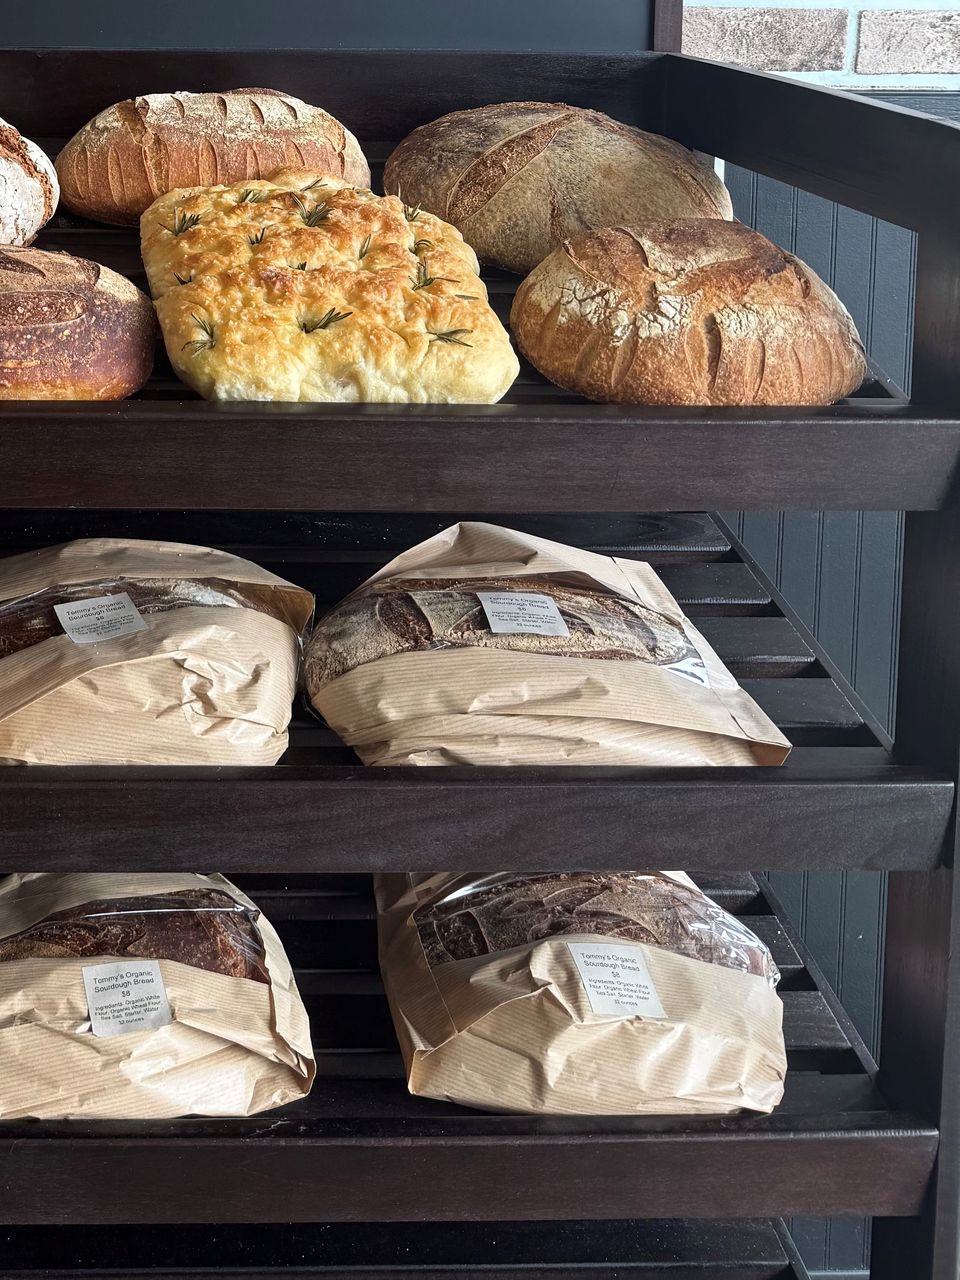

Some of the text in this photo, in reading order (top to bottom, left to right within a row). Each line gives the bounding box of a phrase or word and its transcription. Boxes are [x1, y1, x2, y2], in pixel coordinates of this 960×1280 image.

[580, 953, 637, 964] Tommy's Organic
[584, 960, 619, 969] Sourdough
[93, 973, 124, 984] Tommy's
[94, 982, 132, 993] Sourdough
